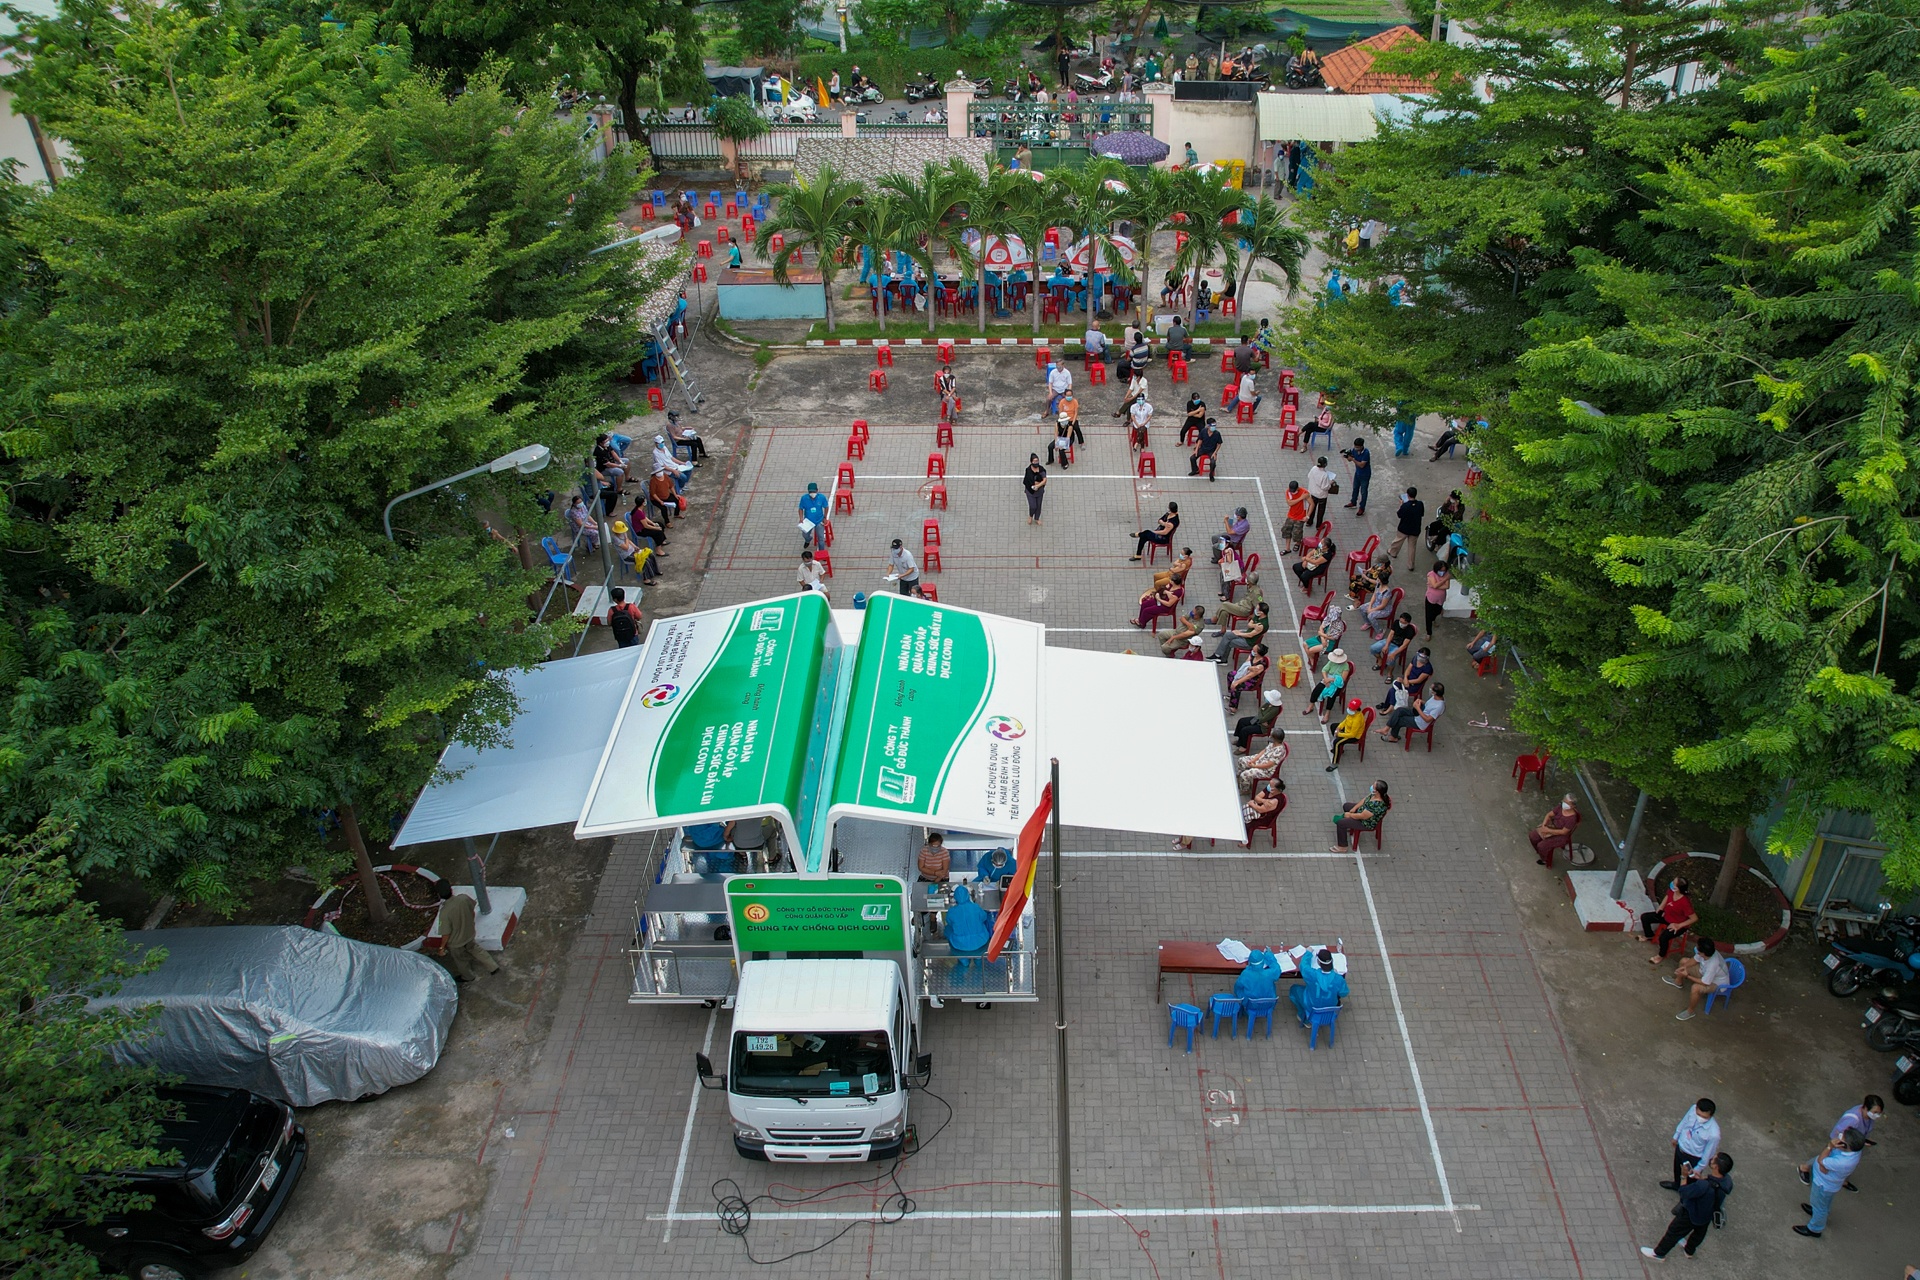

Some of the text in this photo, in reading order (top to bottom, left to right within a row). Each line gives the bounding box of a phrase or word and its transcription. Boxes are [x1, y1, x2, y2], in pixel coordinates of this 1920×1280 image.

[763, 639, 777, 666] CÔNG TY
[898, 634, 912, 672] NHÂN DÂN
[911, 626, 927, 674] QUẬN GÒ VẤP
[926, 611, 943, 677] CHUNG SỨC ĐẨY LÙI
[940, 637, 954, 679] DỊCH COVID
[749, 656, 762, 678] THÀNH
[740, 719, 758, 763] NHÂN DÂN
[883, 724, 899, 757] CÔNG TY
[899, 715, 912, 740] THÀNH
[693, 726, 715, 774] DỊCH COVID
[722, 722, 744, 778] QUẬN GÒ VẤP
[897, 741, 909, 757] ĐỨC
[989, 742, 999, 761] DỤNG
[1011, 745, 1021, 764] ĐỘNG
[700, 723, 729, 805] CHUNG SỨC ĐẨY LÙI
[987, 761, 998, 790] CHUYÊN
[1012, 765, 1020, 778] LƯU
[985, 789, 996, 799] TẾ
[998, 756, 1010, 805] KHÁM BỆNH VÀ
[987, 806, 996, 816] XE
[1009, 804, 1019, 820] TIÊM
[802, 923, 835, 932] CHỐNG
